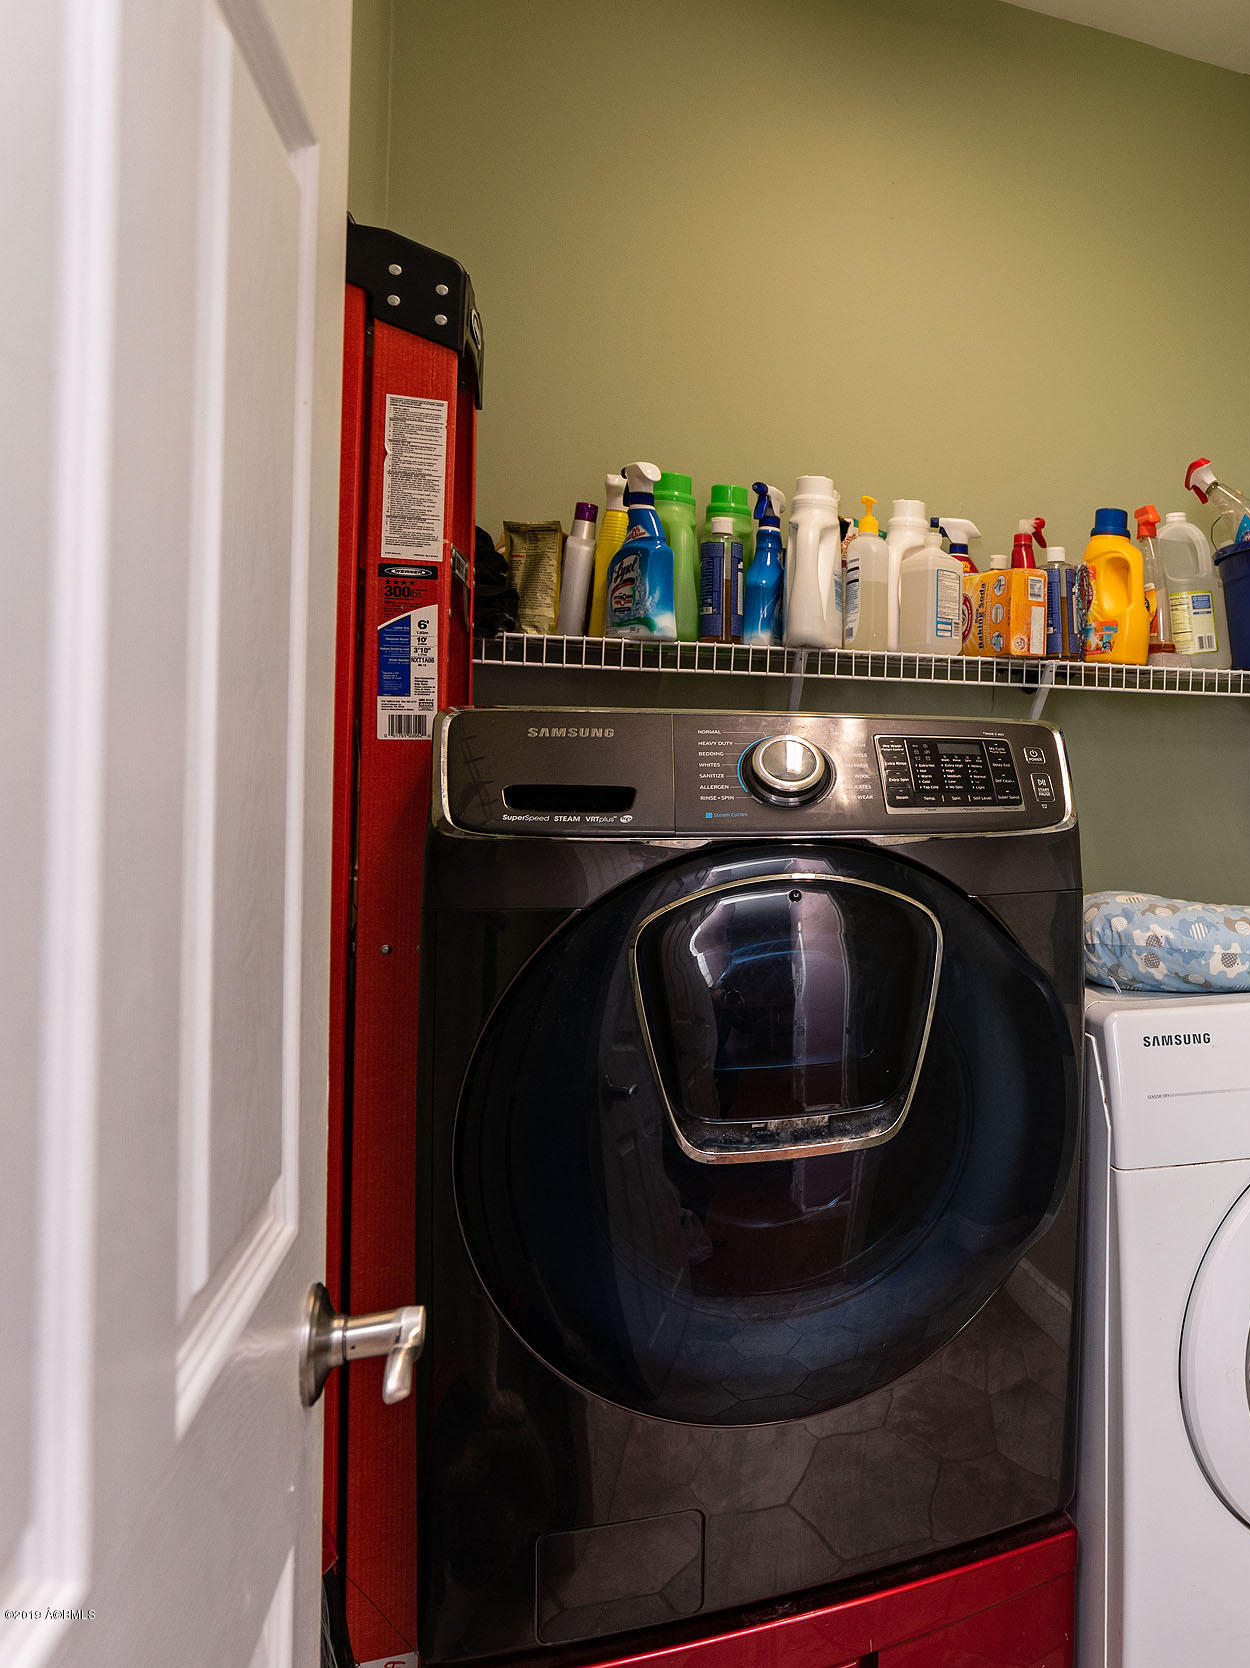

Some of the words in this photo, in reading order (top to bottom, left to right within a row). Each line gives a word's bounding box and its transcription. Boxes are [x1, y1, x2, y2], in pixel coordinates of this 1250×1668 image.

[613, 555, 639, 584] Lysol
[384, 585, 411, 597] 300
[978, 583, 986, 609] Soda
[527, 727, 616, 738] SAMSUNG
[502, 814, 550, 822] SuperSpeed
[1143, 1033, 1211, 1048] SAMSUNG
